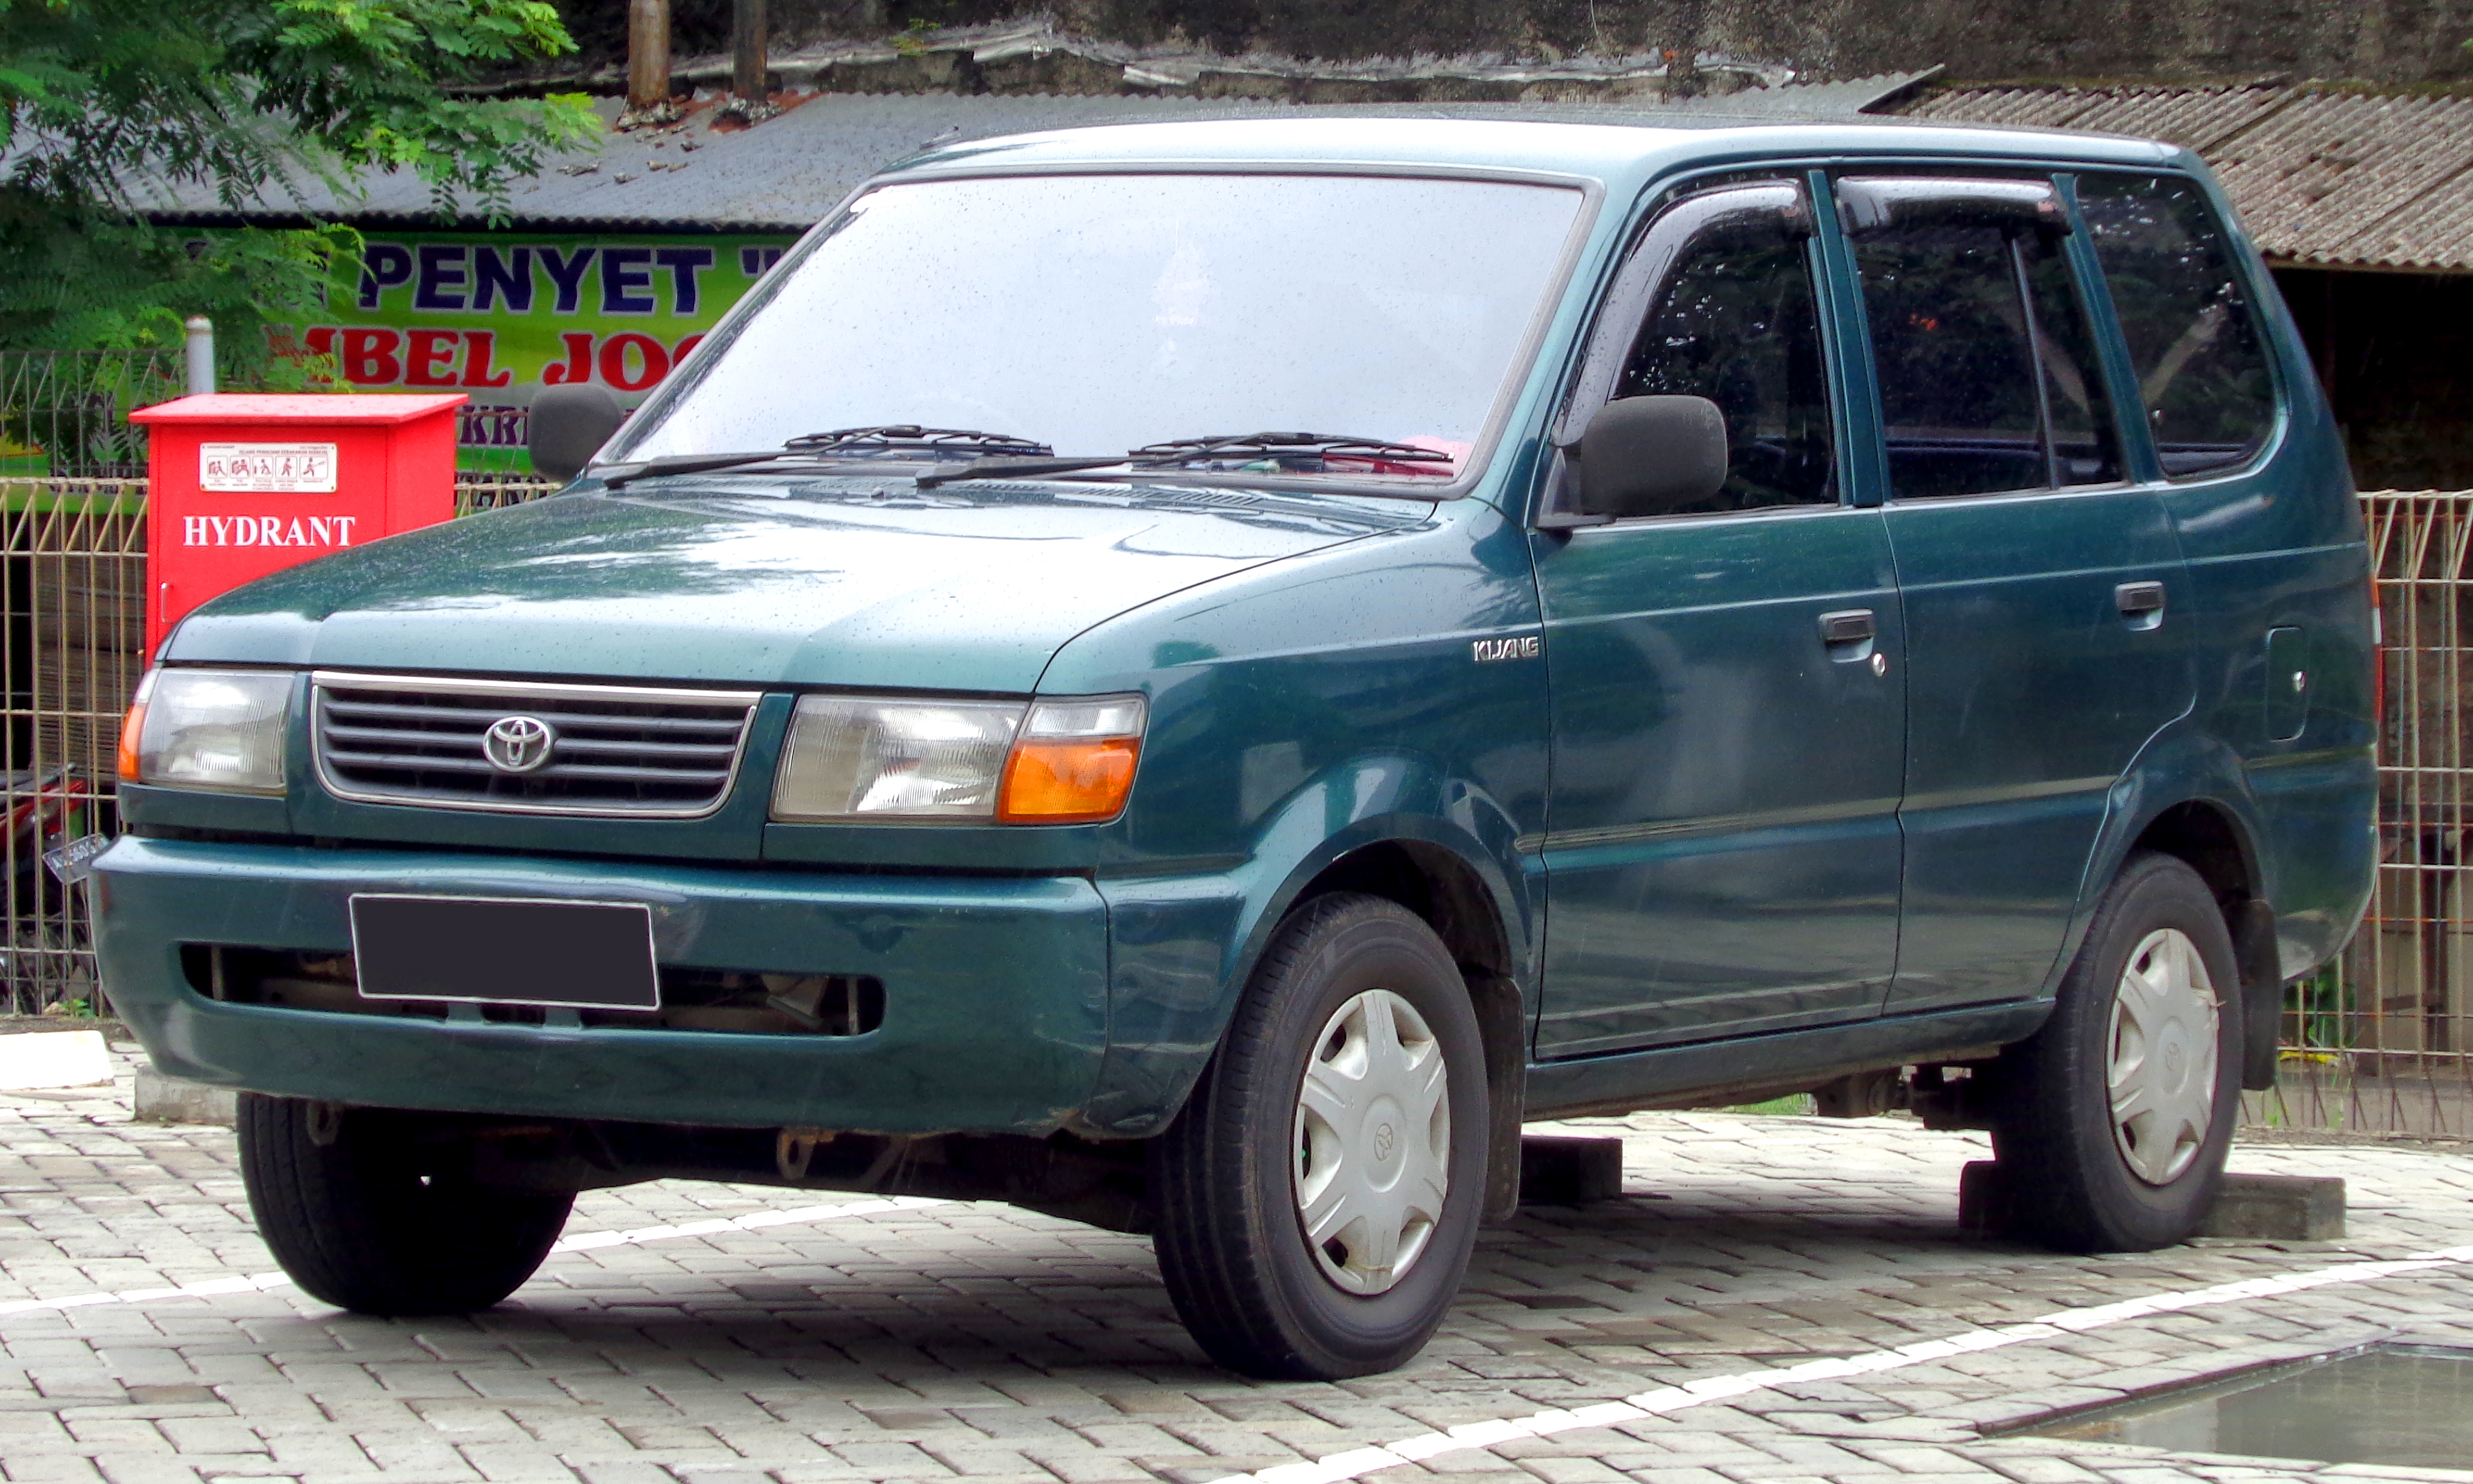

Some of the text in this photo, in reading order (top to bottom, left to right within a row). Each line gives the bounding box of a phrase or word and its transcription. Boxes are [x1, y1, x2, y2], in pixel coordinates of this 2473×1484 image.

[358, 245, 712, 313] PENYET
[543, 333, 706, 391] JO
[182, 515, 355, 546] HYDRANT
